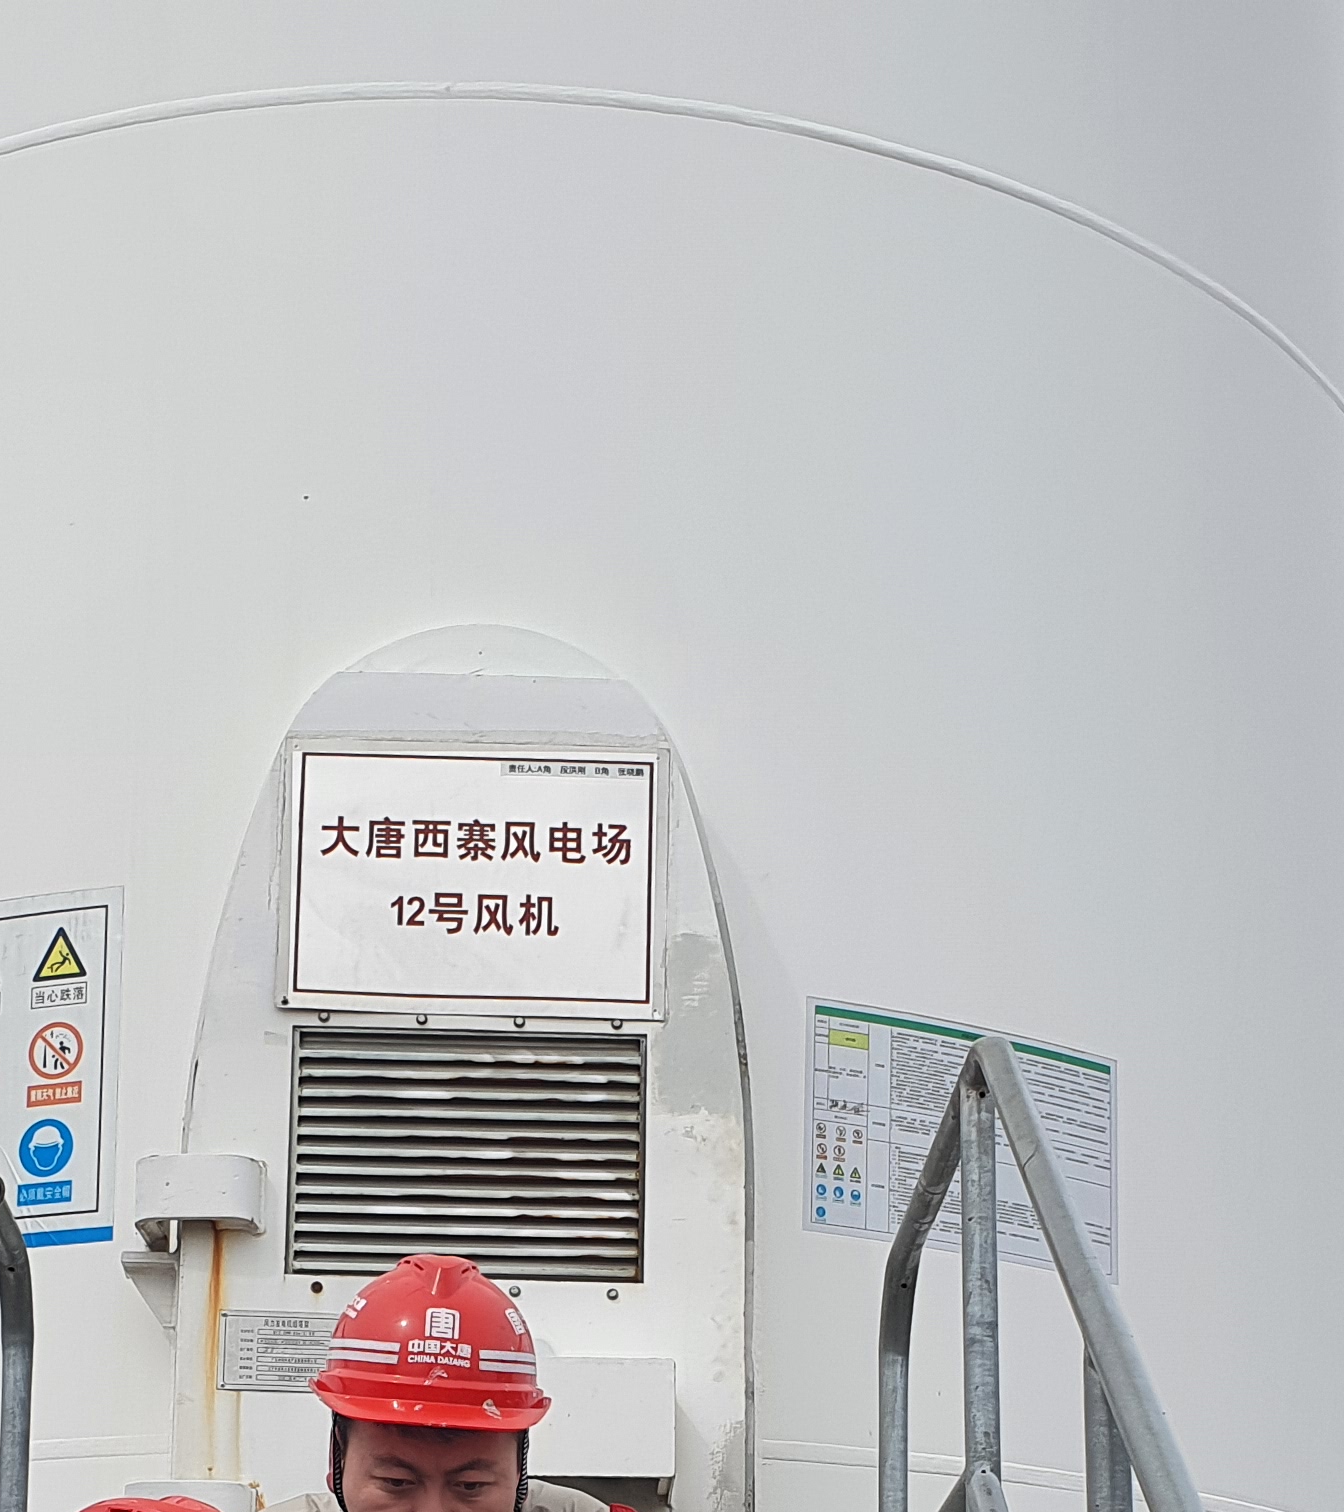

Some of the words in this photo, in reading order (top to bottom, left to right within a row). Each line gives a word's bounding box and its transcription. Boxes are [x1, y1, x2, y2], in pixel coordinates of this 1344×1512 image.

[320, 816, 632, 865] 大唐西寨风电场
[390, 892, 560, 937] 12号风机
[35, 987, 85, 1005] 当心跌落
[407, 1339, 472, 1358] 中国大唐
[407, 1355, 436, 1365] CHINA
[437, 1356, 471, 1368] DATANG
